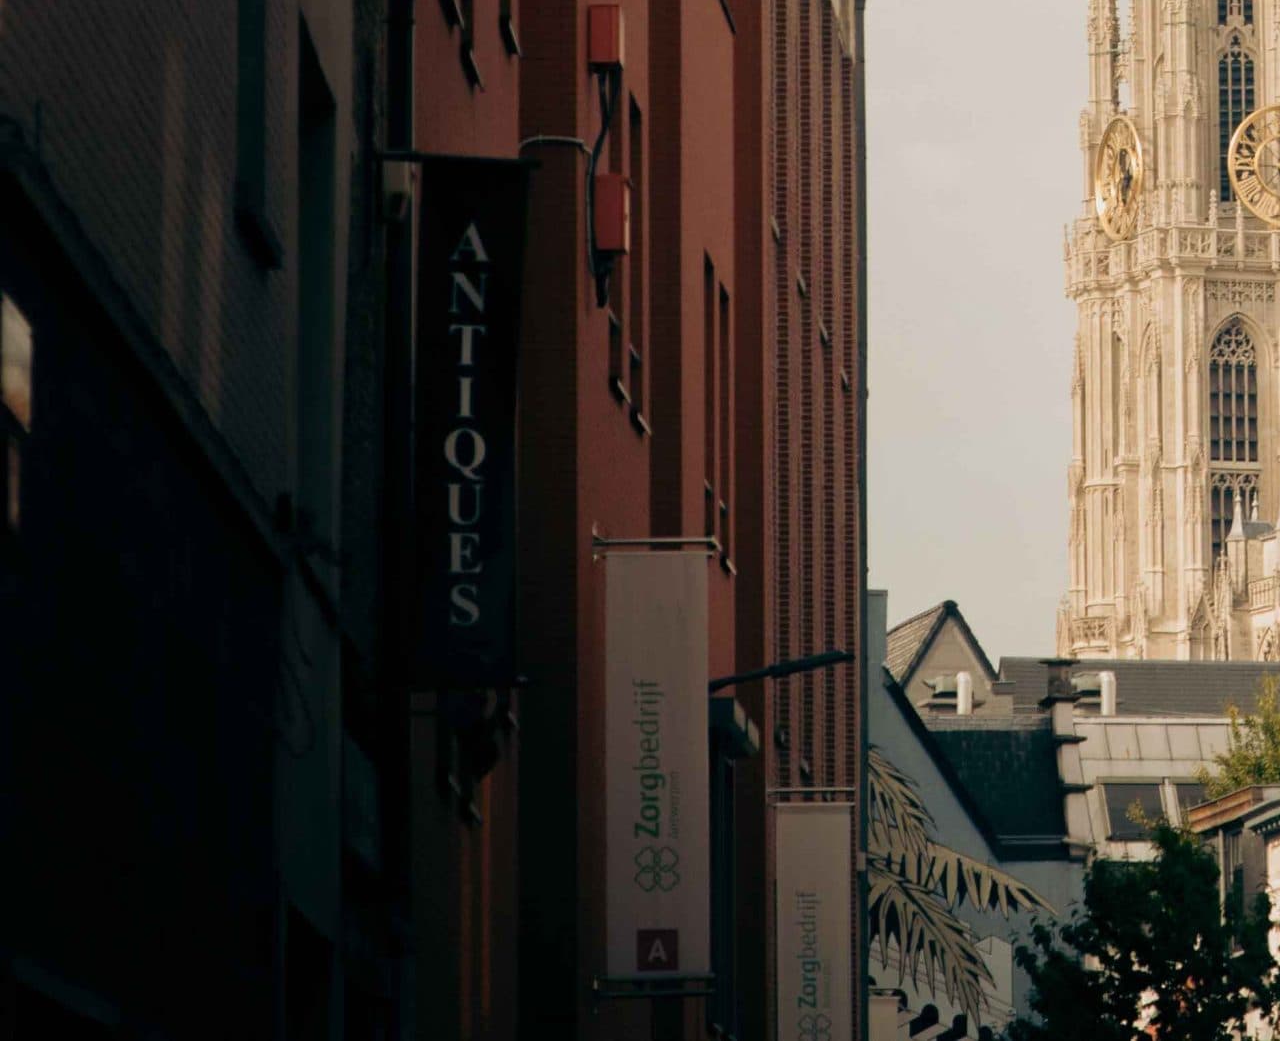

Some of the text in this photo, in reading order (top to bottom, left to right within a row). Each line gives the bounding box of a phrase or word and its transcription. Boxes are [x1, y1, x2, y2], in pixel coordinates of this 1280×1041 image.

[443, 221, 490, 625] ANTIQUES
[633, 679, 665, 839] Zorgbedrijf
[648, 938, 667, 962] A
[795, 888, 821, 1009] Zorgbedrijf
